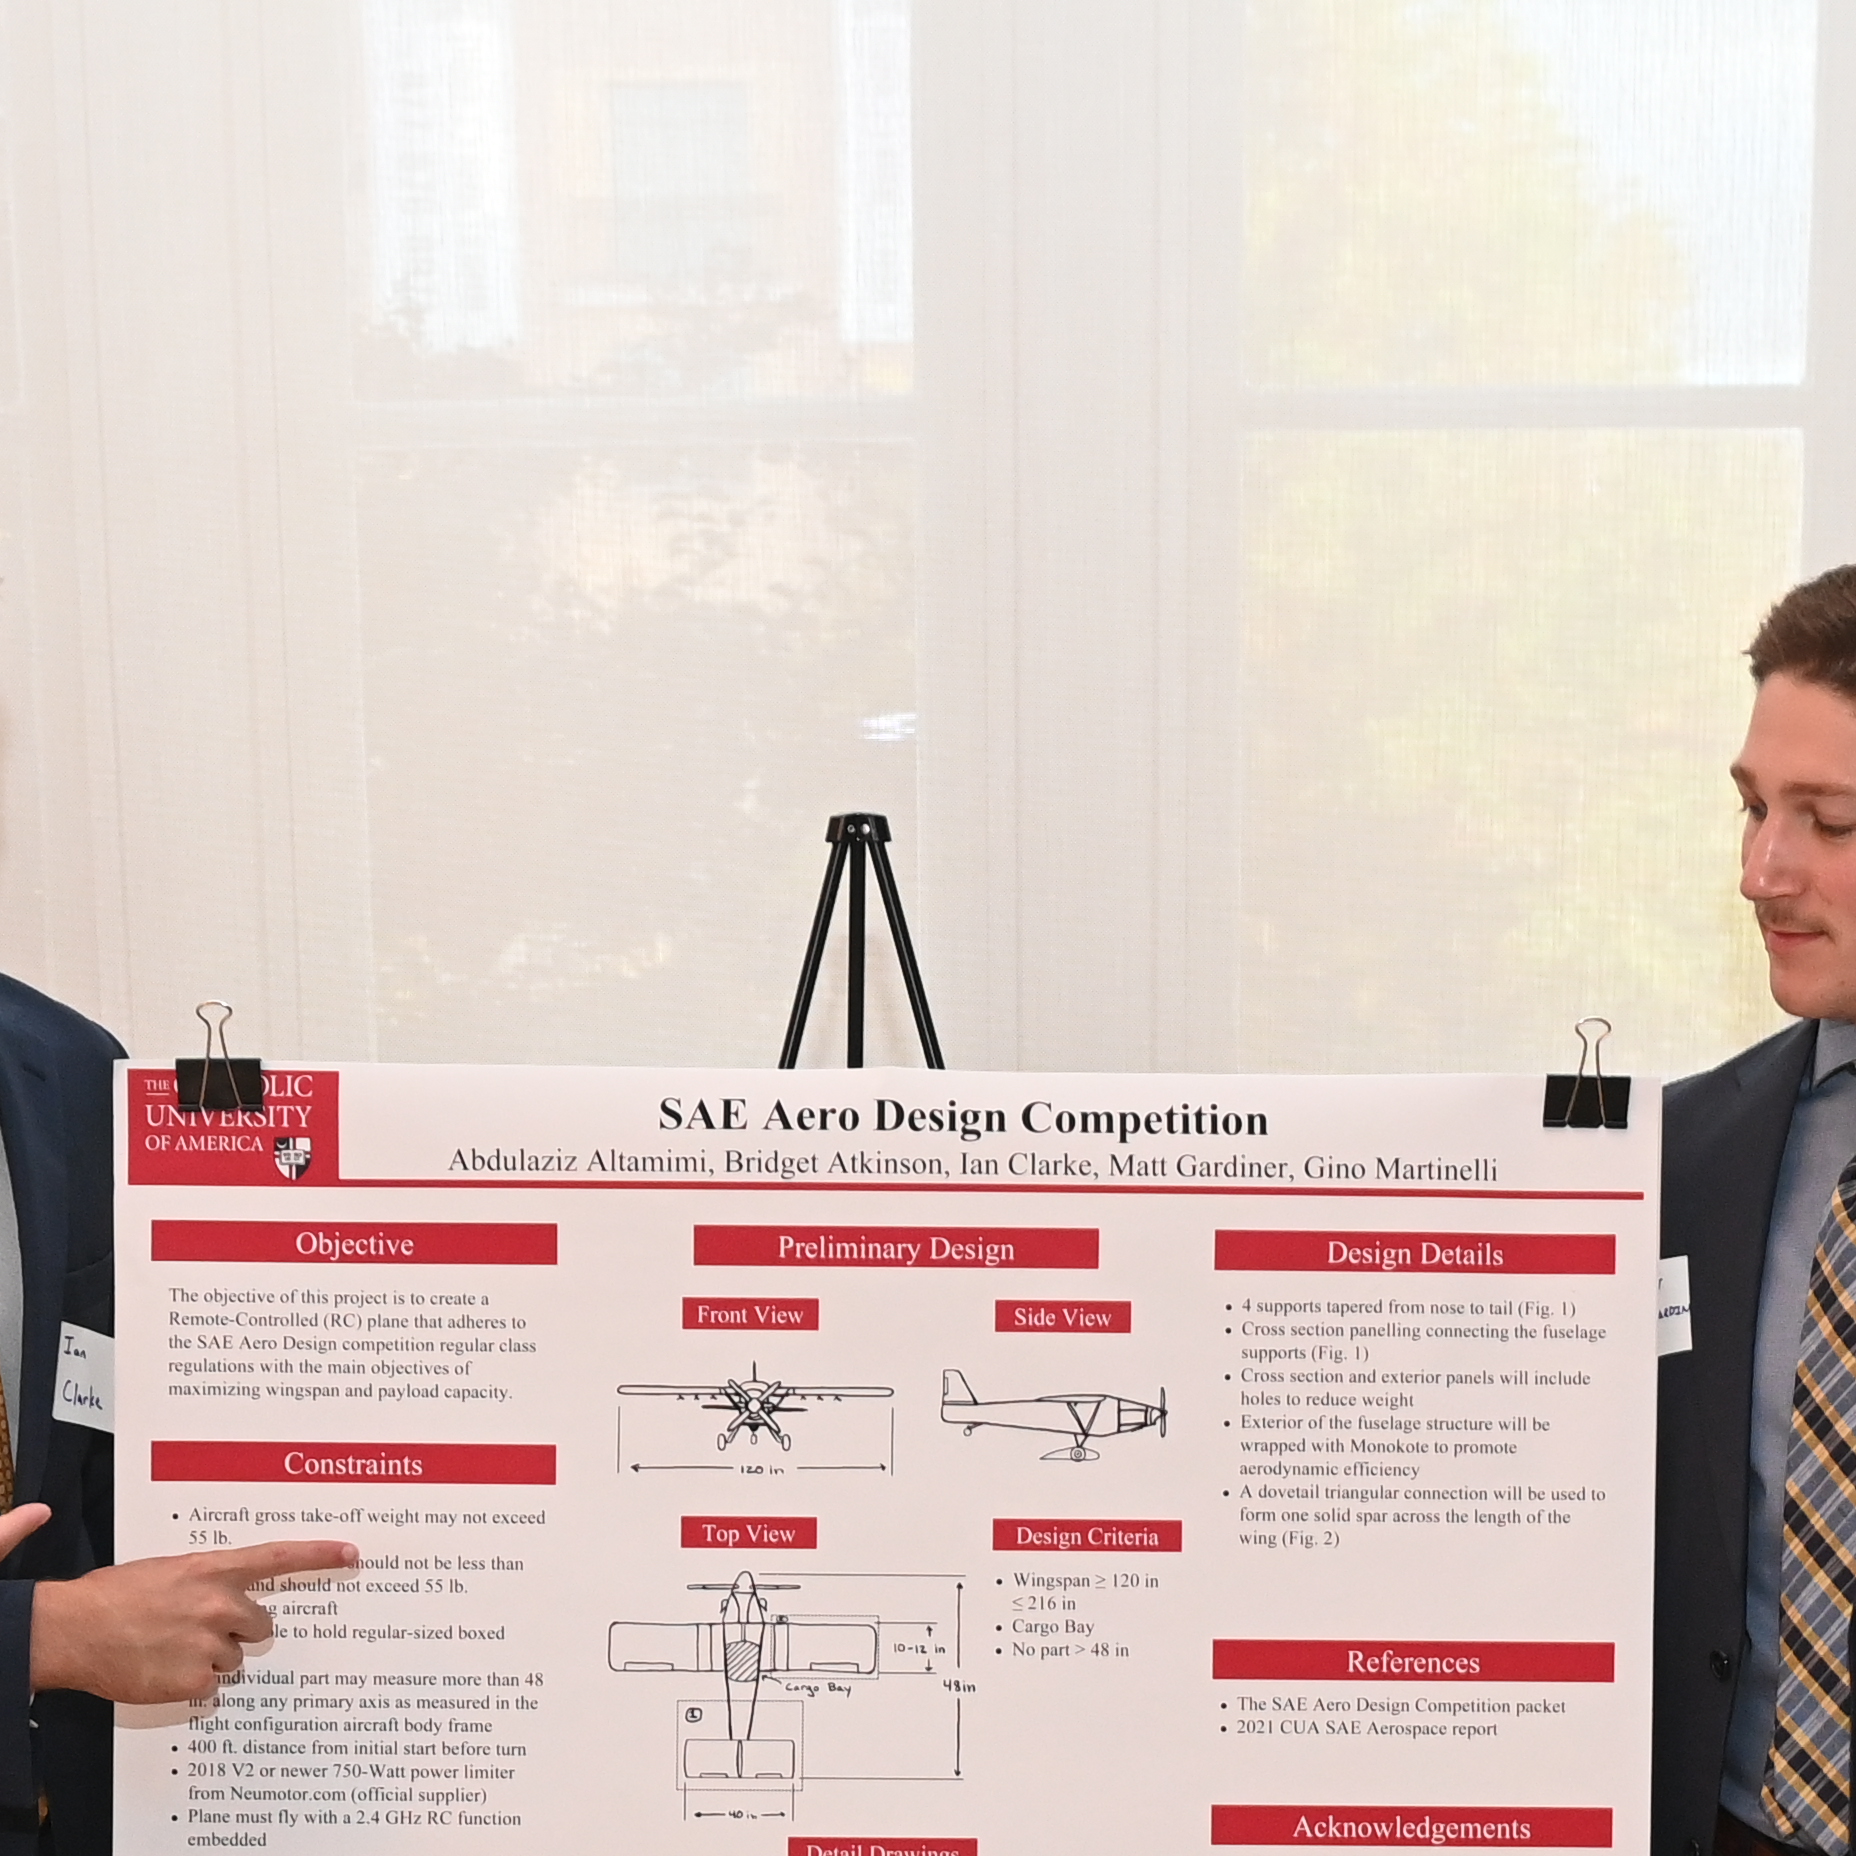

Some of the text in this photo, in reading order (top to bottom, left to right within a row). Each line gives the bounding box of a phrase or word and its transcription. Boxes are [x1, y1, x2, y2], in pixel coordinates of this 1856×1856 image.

[145, 1080, 170, 1090] THE
[145, 1105, 313, 1128] UNIVERSITY
[660, 1098, 1268, 1144] SAE Aero Design Competition
[145, 1135, 264, 1152] OF AMERICA
[449, 1148, 1496, 1182] Abdulaziz Altamimi, Bridget Atkinson, Ian Clarke, Matt Gardiner, Gino Martinelli
[296, 1232, 414, 1261] Objective
[780, 1235, 1014, 1266] Preliminary Design
[1328, 1241, 1504, 1270] Design Details
[169, 1288, 489, 1308] The objective of this project is to create a
[698, 1305, 803, 1324] Front View
[1015, 1308, 1112, 1326] Side View
[1242, 1298, 1576, 1320] 4 supports tapered from nose to tail (Fig. 1)
[170, 1312, 526, 1332] Remote-Controlled (RC) plane that adheres to
[64, 1336, 86, 1359] Ian
[63, 1379, 103, 1410] Clarke
[285, 1452, 423, 1476] Constraints
[740, 1465, 785, 1475] 120 in
[702, 1524, 796, 1547] Top View
[1017, 1527, 1159, 1550] Design Criteria
[1014, 1572, 1090, 1592] Wingspan
[1114, 1574, 1140, 1588] 120
[1146, 1574, 1158, 1588] in
[1028, 1596, 1056, 1610] 216
[1063, 1596, 1076, 1610] in
[1013, 1619, 1094, 1638] Cargo Bay
[893, 1643, 946, 1654] 10-12 in
[1013, 1642, 1036, 1656] No
[1041, 1645, 1070, 1660] part
[1091, 1643, 1110, 1657] 48
[1116, 1643, 1129, 1657] in
[1348, 1650, 1480, 1674] References
[785, 1682, 852, 1698] Cargo Bay
[1237, 1697, 1566, 1717] The SAE Aero Design Competition packet
[1237, 1720, 1497, 1740] 2021 CUA SAE Aerospace report
[188, 1739, 526, 1756] 400 ft. distance from initial start before turn
[1293, 1815, 1531, 1845] Acknowledgements
